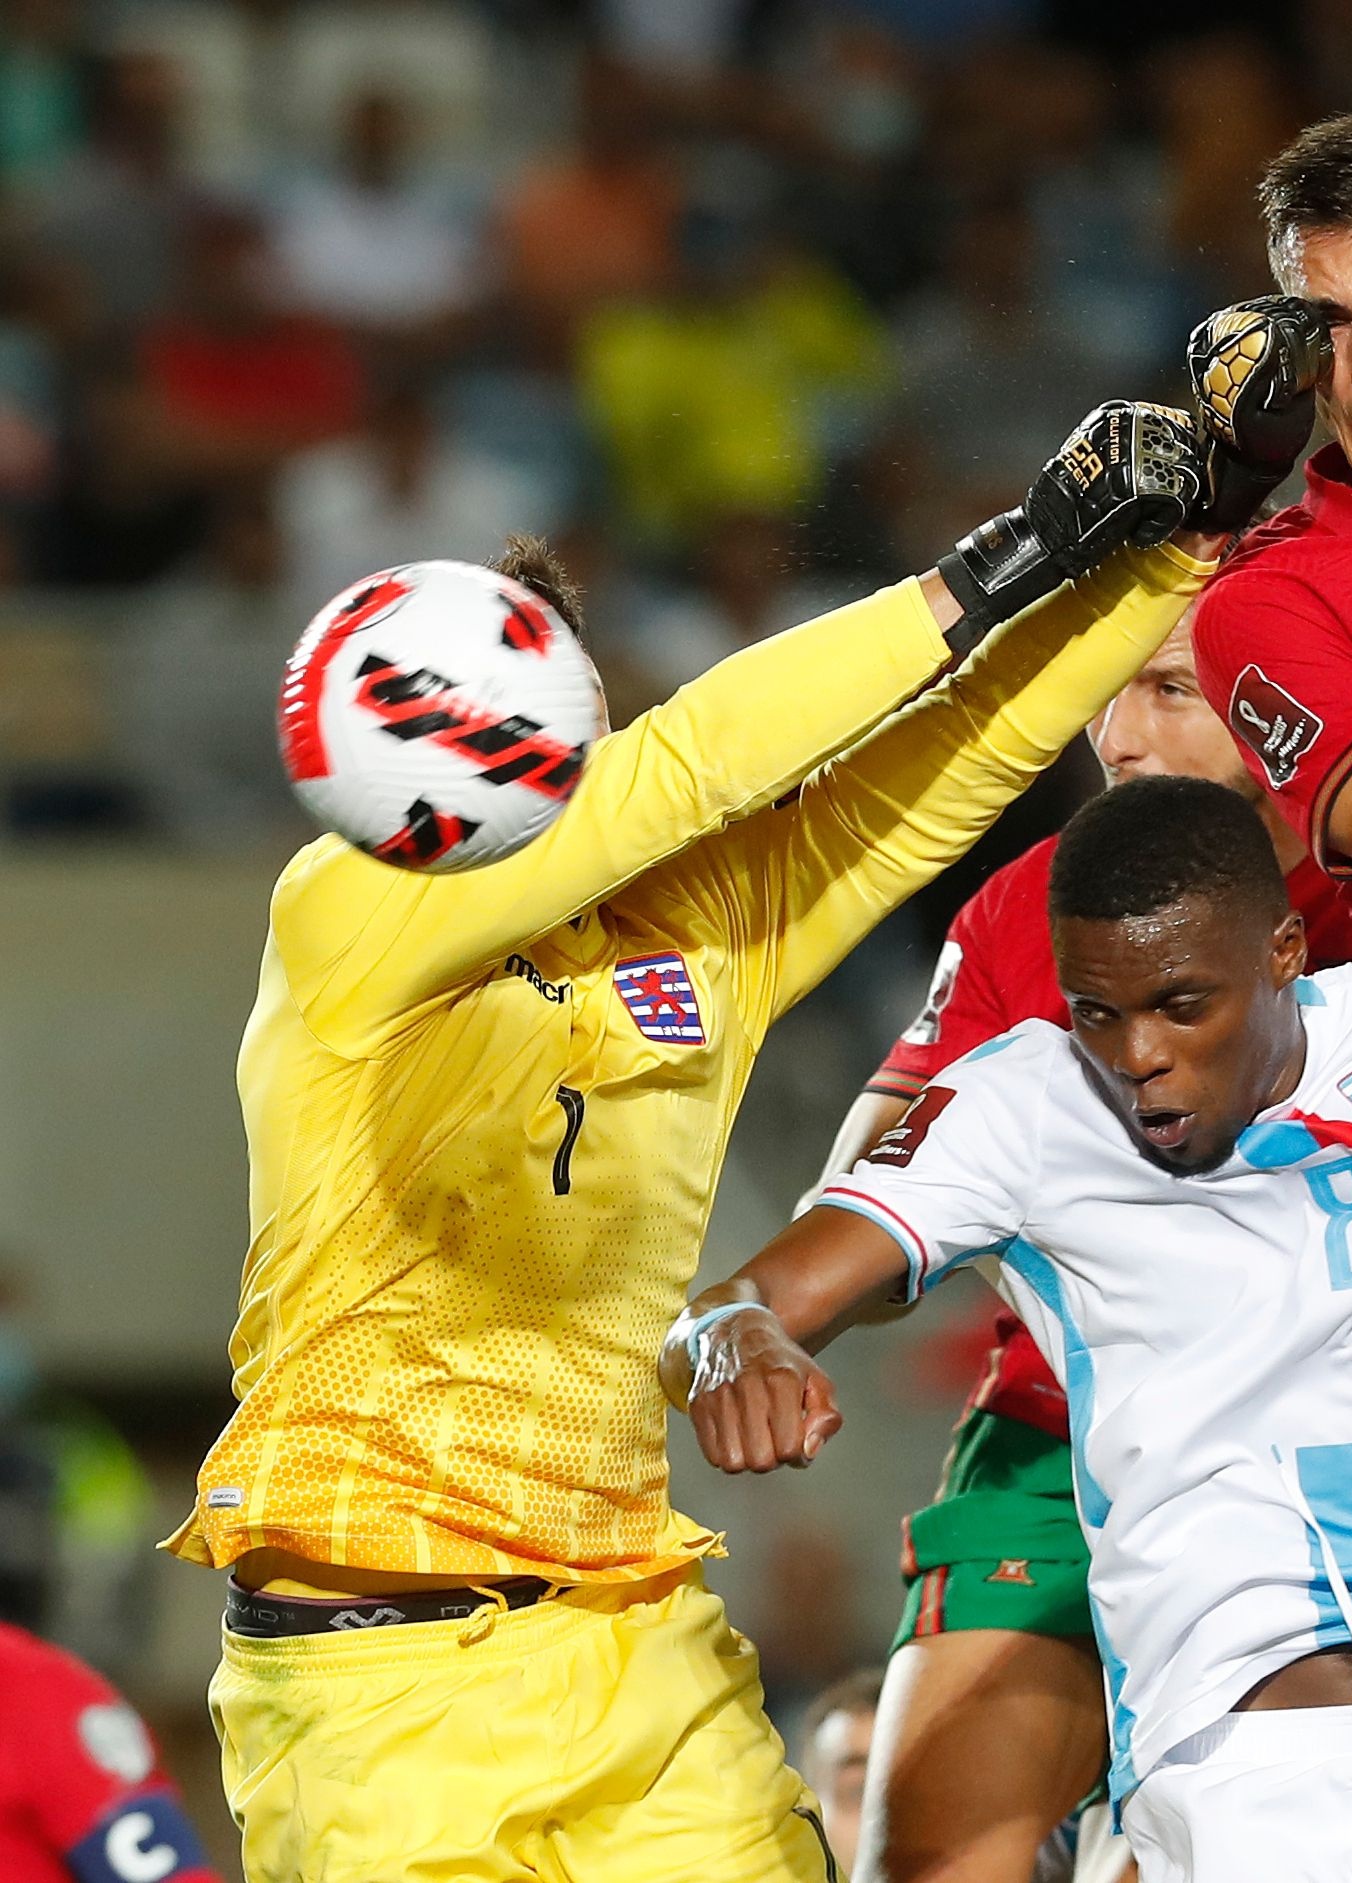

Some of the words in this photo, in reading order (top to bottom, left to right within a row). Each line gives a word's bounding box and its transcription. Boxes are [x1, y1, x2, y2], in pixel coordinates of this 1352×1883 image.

[504, 953, 573, 1004] macr
[553, 1084, 585, 1195] 1
[104, 1811, 179, 1883] C
